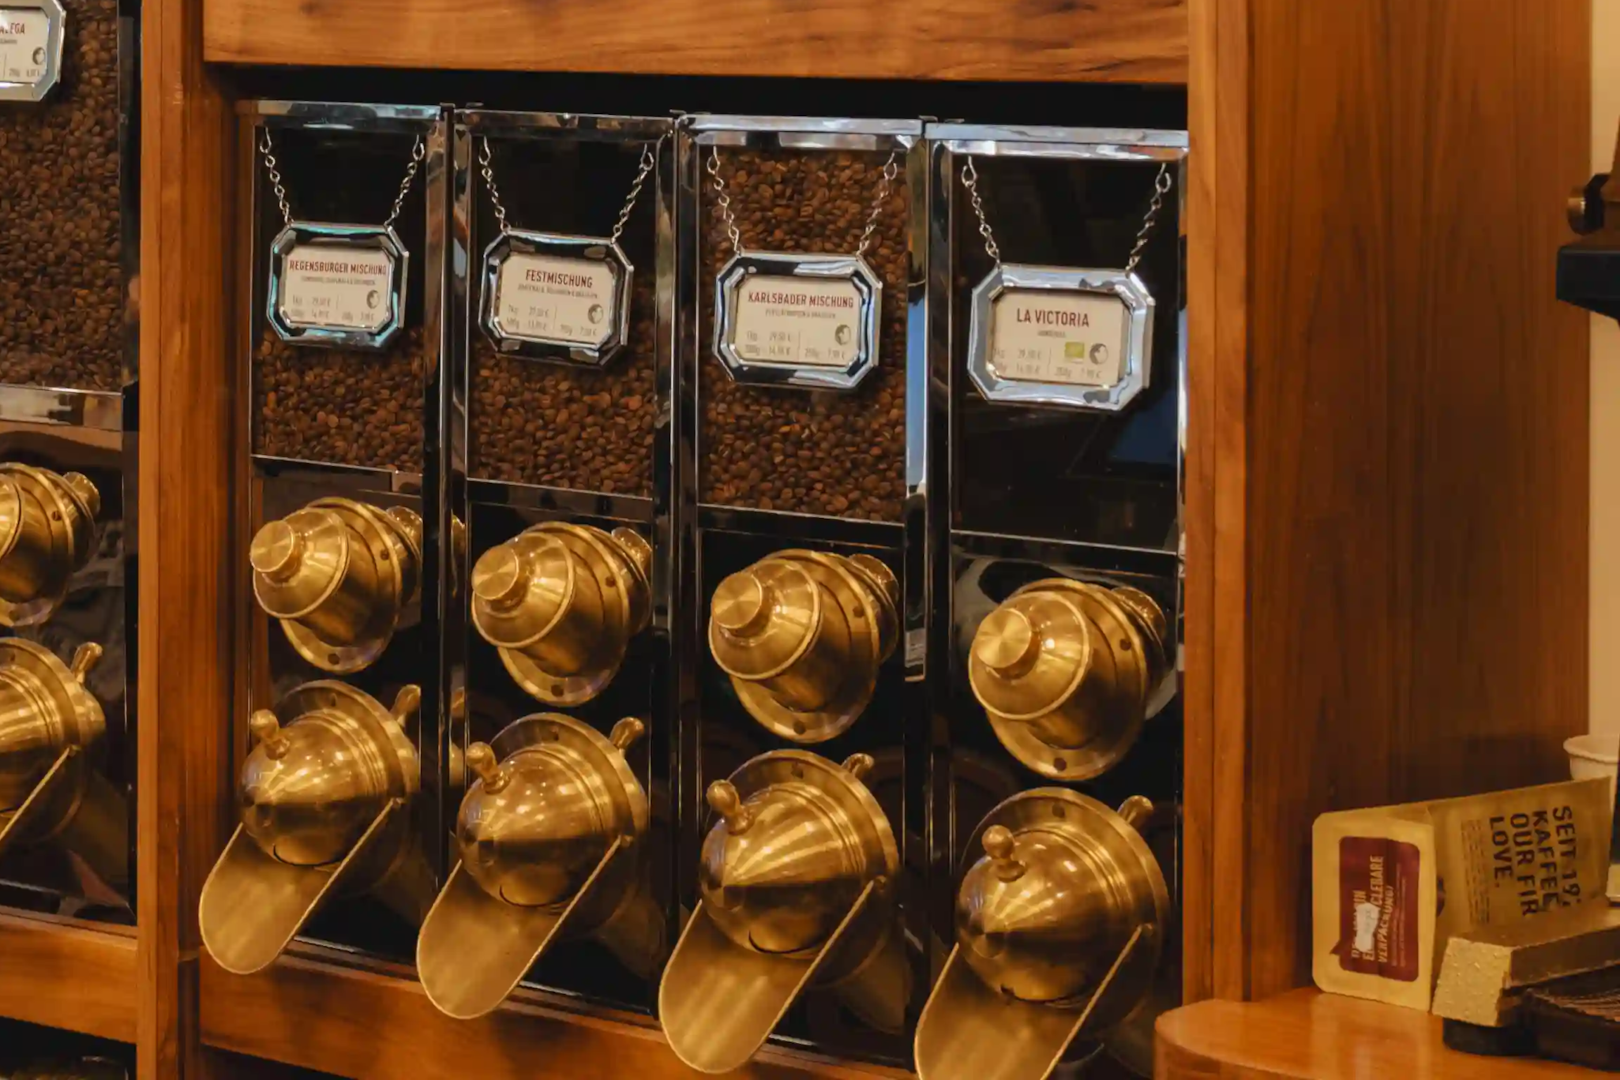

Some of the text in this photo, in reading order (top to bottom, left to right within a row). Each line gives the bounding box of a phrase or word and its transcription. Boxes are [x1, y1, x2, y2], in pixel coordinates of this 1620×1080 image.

[289, 259, 387, 276] REGENSBURGER MISCHUNG
[525, 269, 593, 289] FESTMISCHUNG
[748, 290, 854, 309] KARLSBADER MISCHUNG
[1016, 307, 1090, 328] LA VICTORIA
[1510, 813, 1535, 867] OUR
[1552, 806, 1577, 859] SEIT
[1490, 816, 1513, 888] LOVE.
[1532, 810, 1560, 909] KAFFEE
